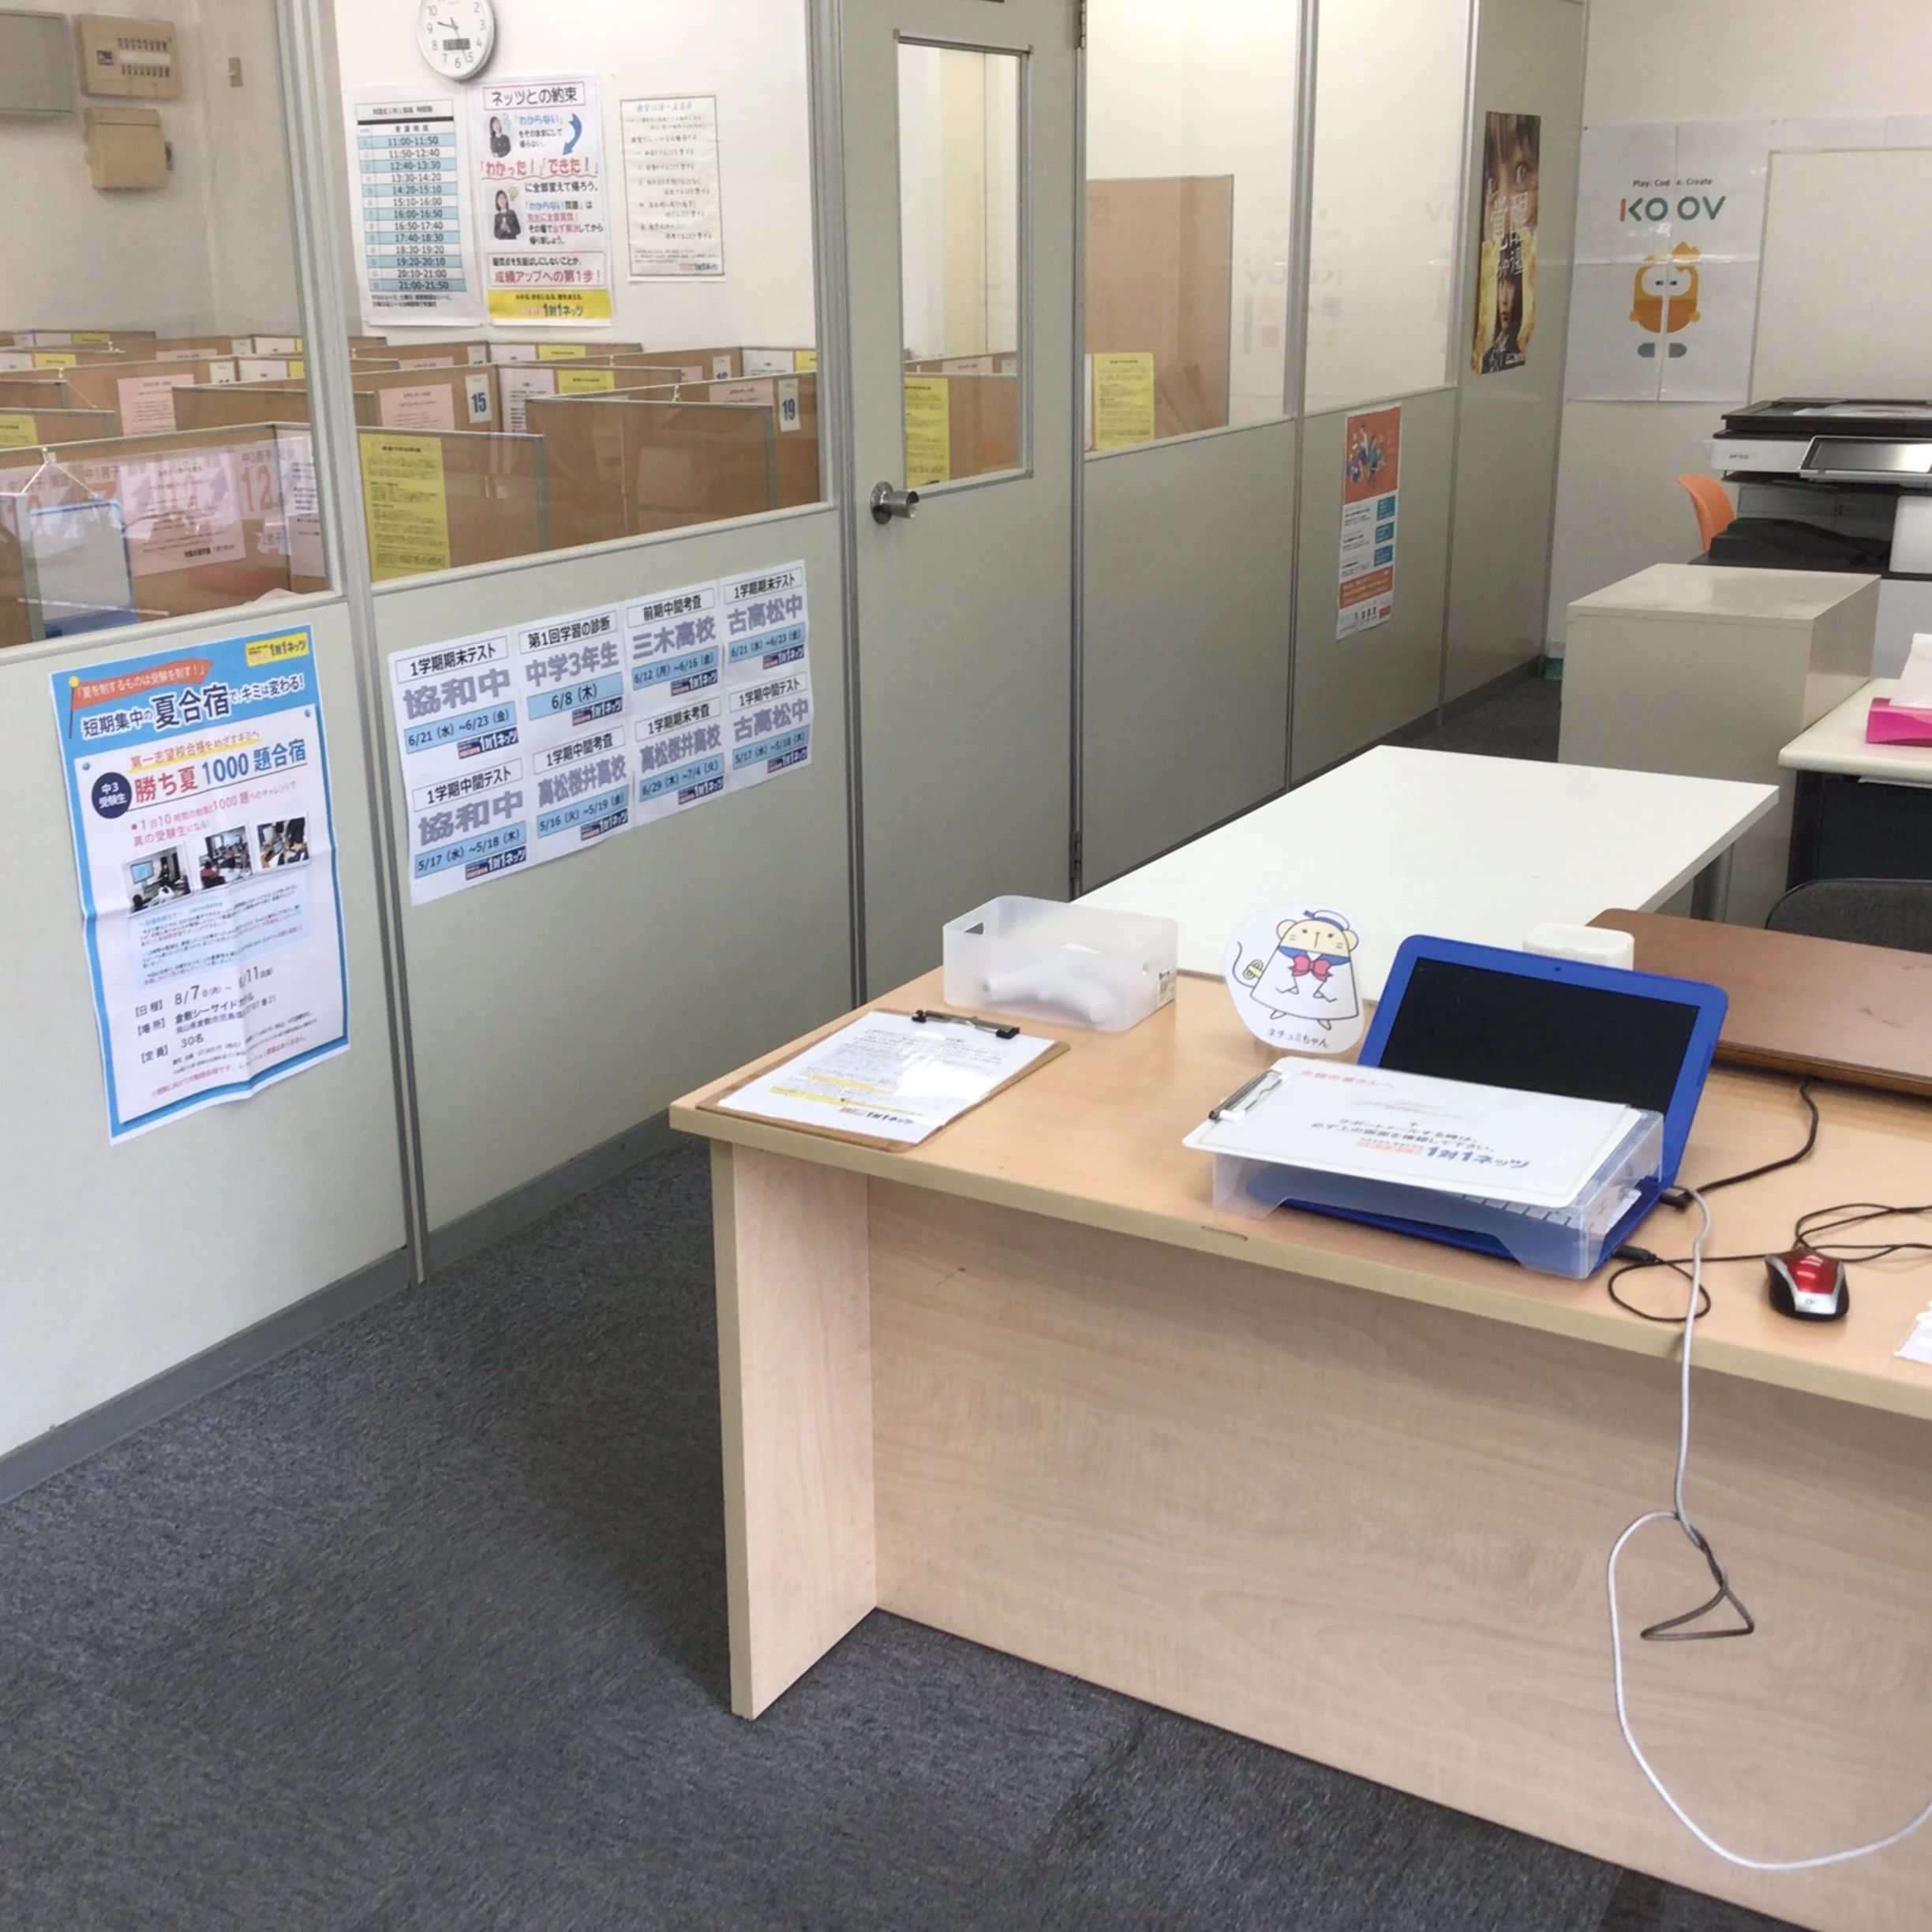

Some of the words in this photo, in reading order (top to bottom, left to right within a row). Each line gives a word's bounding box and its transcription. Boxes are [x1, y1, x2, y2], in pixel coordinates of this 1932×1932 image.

[492, 87, 577, 106] ネッツとの約束
[388, 136, 439, 146] 11:00-11:50
[389, 148, 440, 158] 11:50-12:40
[391, 161, 440, 170] 12:40-13:30
[391, 173, 441, 182] 13:30-14:20
[392, 185, 442, 195] 14:20-15:10
[393, 197, 442, 206] 15:10-16:00
[395, 209, 443, 219] 16:00-16:50
[395, 222, 443, 230] 16:50-17:40
[395, 234, 444, 242] 17:40-18:30
[396, 245, 444, 254] 18:30-19:20
[397, 257, 445, 266] 19:20-20:10
[398, 269, 447, 278] 20:10-21:00
[399, 281, 449, 290] 21:00-21:50
[471, 392, 486, 413] 15
[782, 399, 796, 421] 19
[734, 573, 795, 600] 1学期期末テスト
[643, 594, 702, 621] 前期中間考査
[728, 594, 803, 635] 古高松中
[527, 616, 610, 648] 第1回学習の診断
[632, 616, 716, 660] 三木高校
[410, 642, 496, 676] 1学期期末テスト
[526, 641, 619, 687] 中学3年生
[402, 668, 511, 720] 協和中
[739, 680, 799, 706] 1学期中間テスト
[648, 703, 710, 734] 1学期期末考査
[733, 698, 808, 742] 古高松中
[546, 732, 612, 767] 1学期中間考査
[134, 766, 197, 803] 勝ち夏
[201, 752, 249, 784] 1000
[253, 738, 306, 773] 題合宿
[101, 781, 119, 794] 中3
[427, 766, 511, 803] 1学期中間テスト
[99, 792, 127, 809] 受験生
[418, 790, 523, 846] 協和中
[181, 1033, 204, 1049] 30名
[1427, 1146, 1530, 1169] 1対1ネッツ
